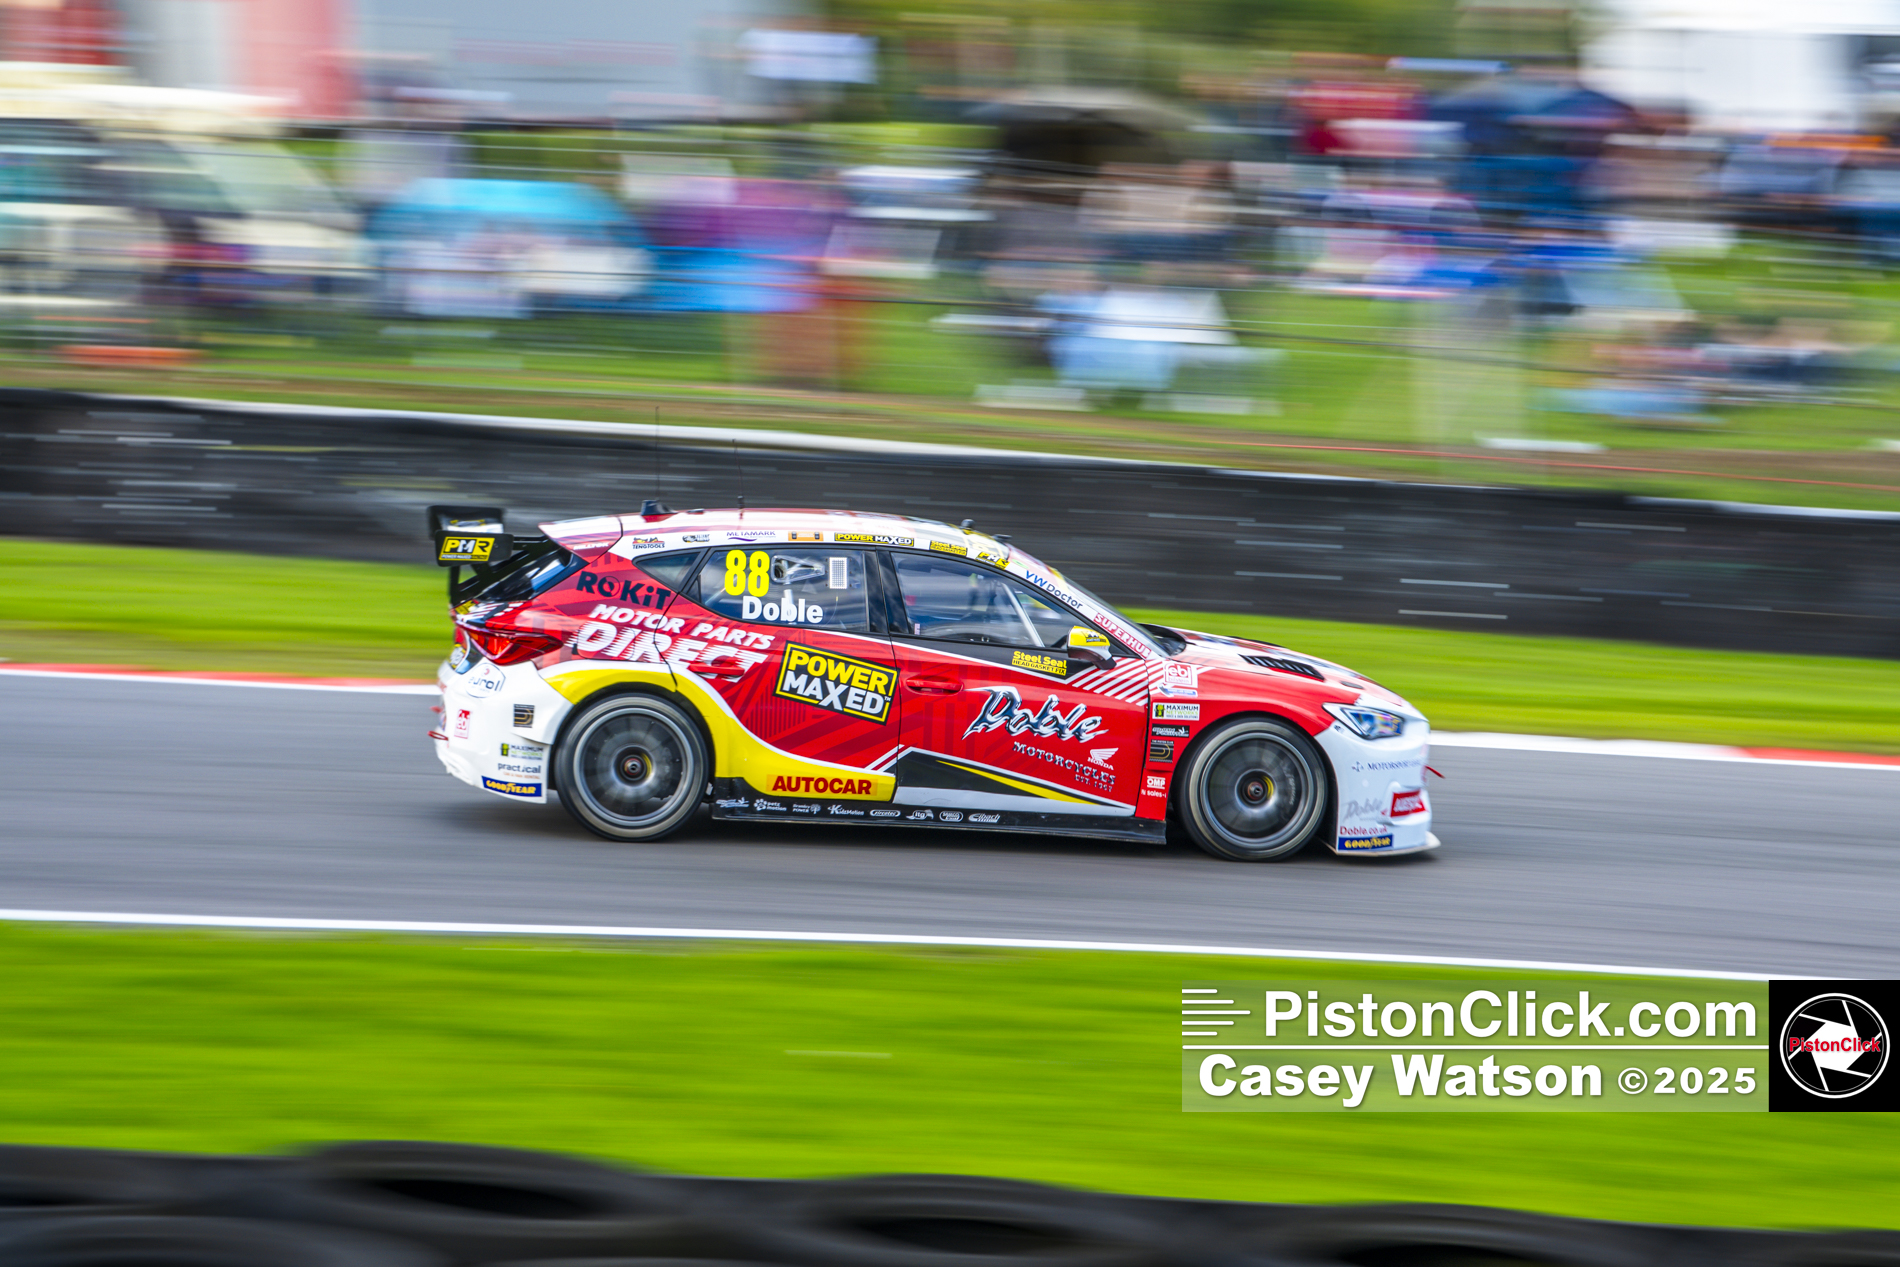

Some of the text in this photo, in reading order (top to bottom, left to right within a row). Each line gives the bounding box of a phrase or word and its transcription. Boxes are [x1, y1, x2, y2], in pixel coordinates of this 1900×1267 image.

[444, 539, 490, 553] PMR
[837, 533, 912, 544] POWER MAXED
[724, 549, 770, 597] 88
[1025, 570, 1083, 609] VW Doctor
[742, 595, 824, 623] Doble
[588, 603, 775, 650] MOTOR PARTS
[1095, 613, 1151, 658] SUPERHUB
[565, 620, 768, 683] DIRECT
[1013, 650, 1067, 669] Steel Seal
[1030, 663, 1054, 671] GASKET
[787, 649, 889, 695] POWER
[782, 670, 884, 714] MAXED
[961, 685, 1109, 743] Doble
[1012, 741, 1116, 785] MOTORCYCLES
[1087, 756, 1114, 771] HONDA
[486, 779, 537, 794] GOODYEAR
[772, 775, 872, 795] AUTOCAR
[1147, 778, 1165, 787] OMP
